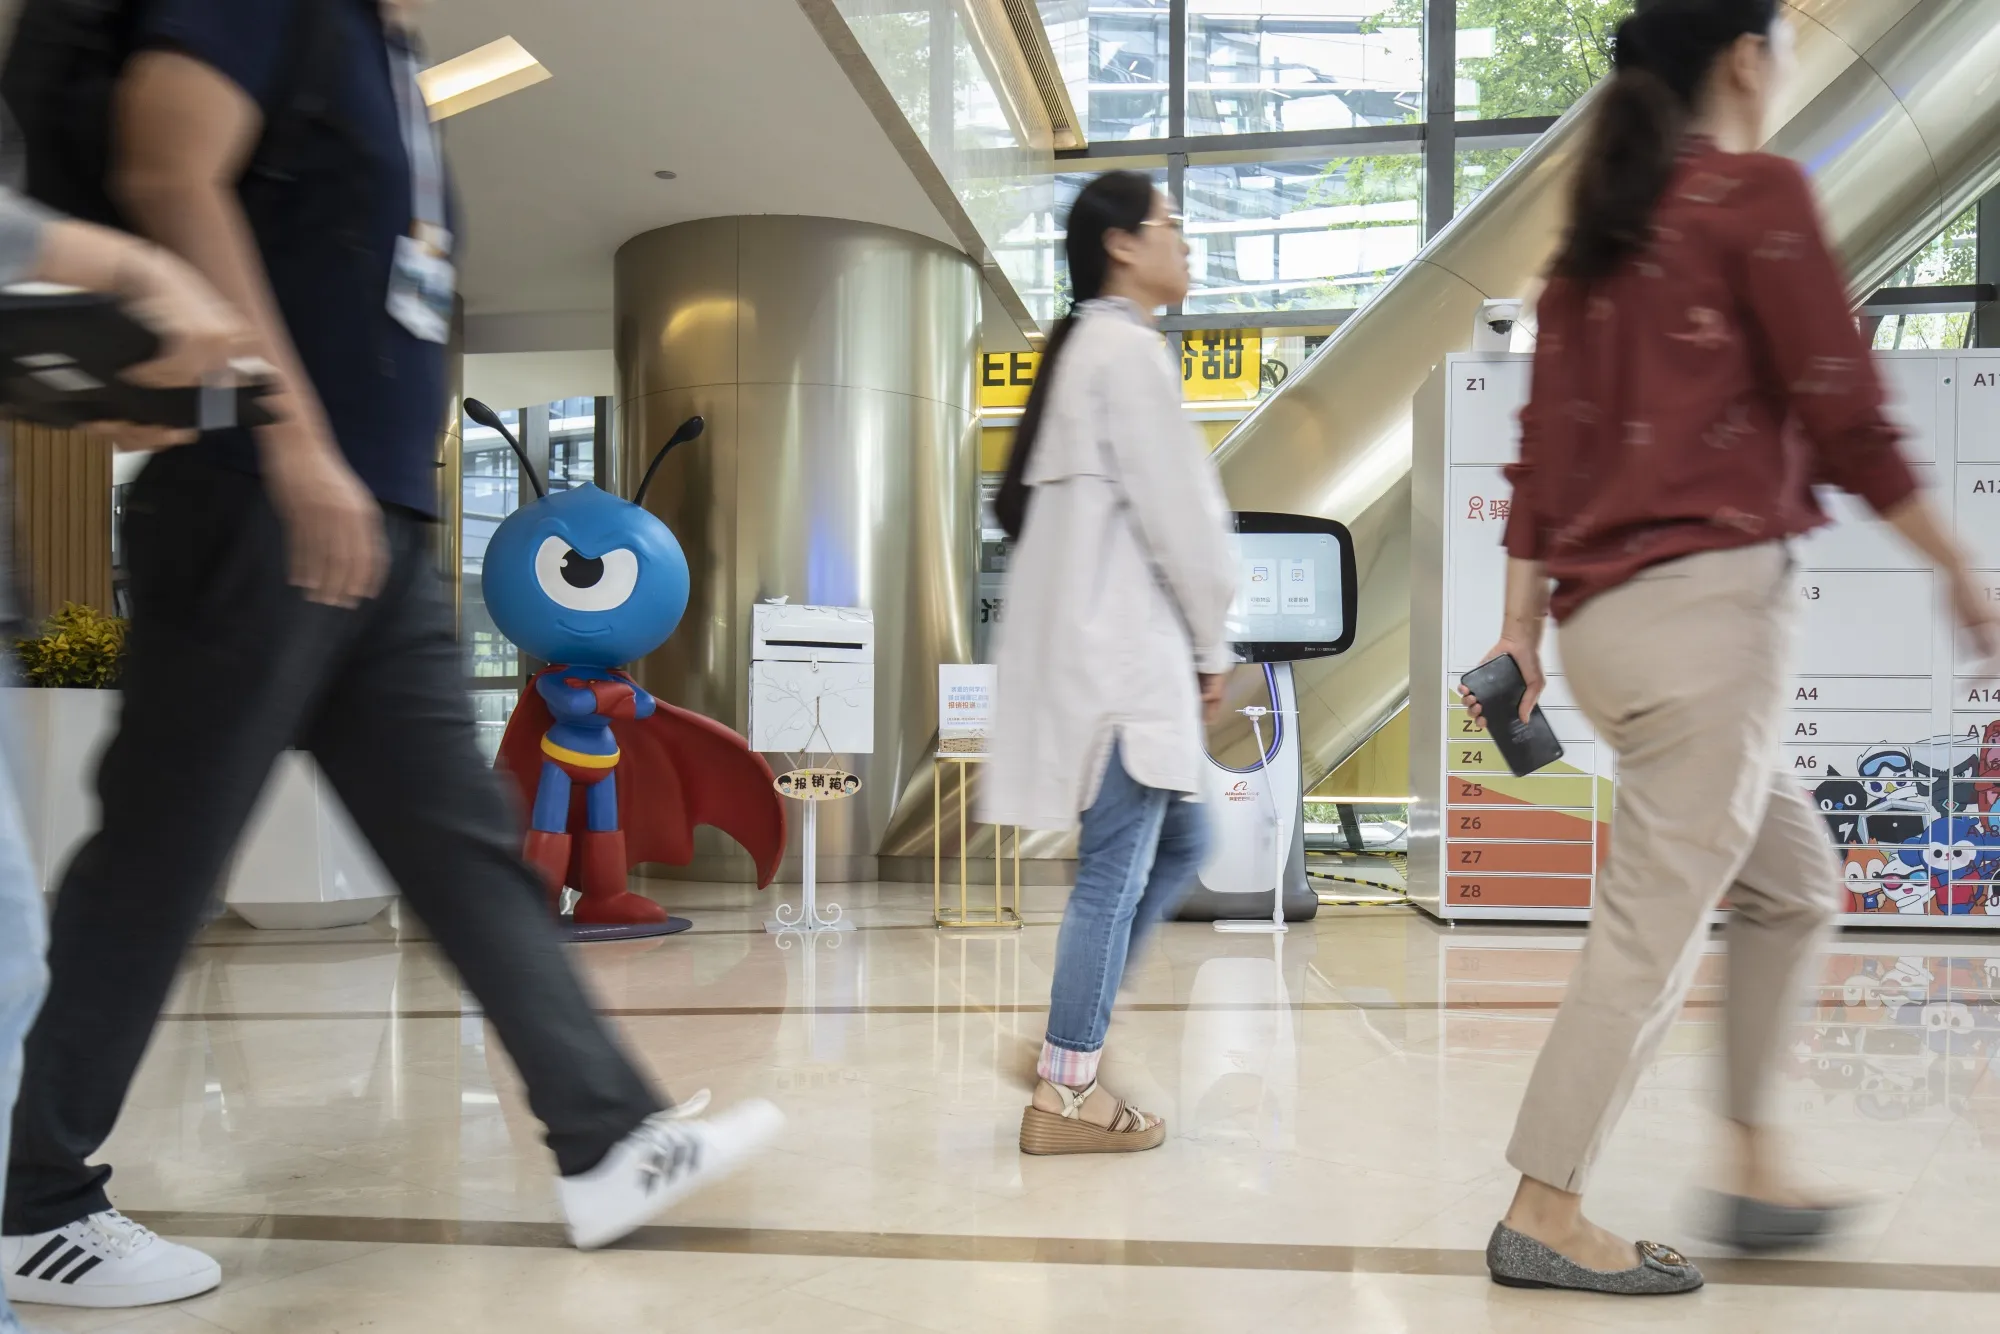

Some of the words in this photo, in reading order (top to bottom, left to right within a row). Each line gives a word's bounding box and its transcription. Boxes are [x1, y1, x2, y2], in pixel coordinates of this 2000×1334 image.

[1466, 378, 1485, 390] Z1
[1973, 373, 2000, 386] A1
[1489, 500, 1511, 520] 驿
[1795, 687, 1818, 700] A4
[1968, 689, 2000, 702] A14
[1795, 723, 1818, 736] A5
[1461, 751, 1483, 764] Z4
[1794, 756, 1817, 768] A6
[794, 774, 842, 790] 报销箱
[1461, 784, 1483, 796] Z5
[1460, 817, 1482, 829] Z6
[1461, 851, 1482, 863] Z7
[1460, 885, 1481, 898] Z8
